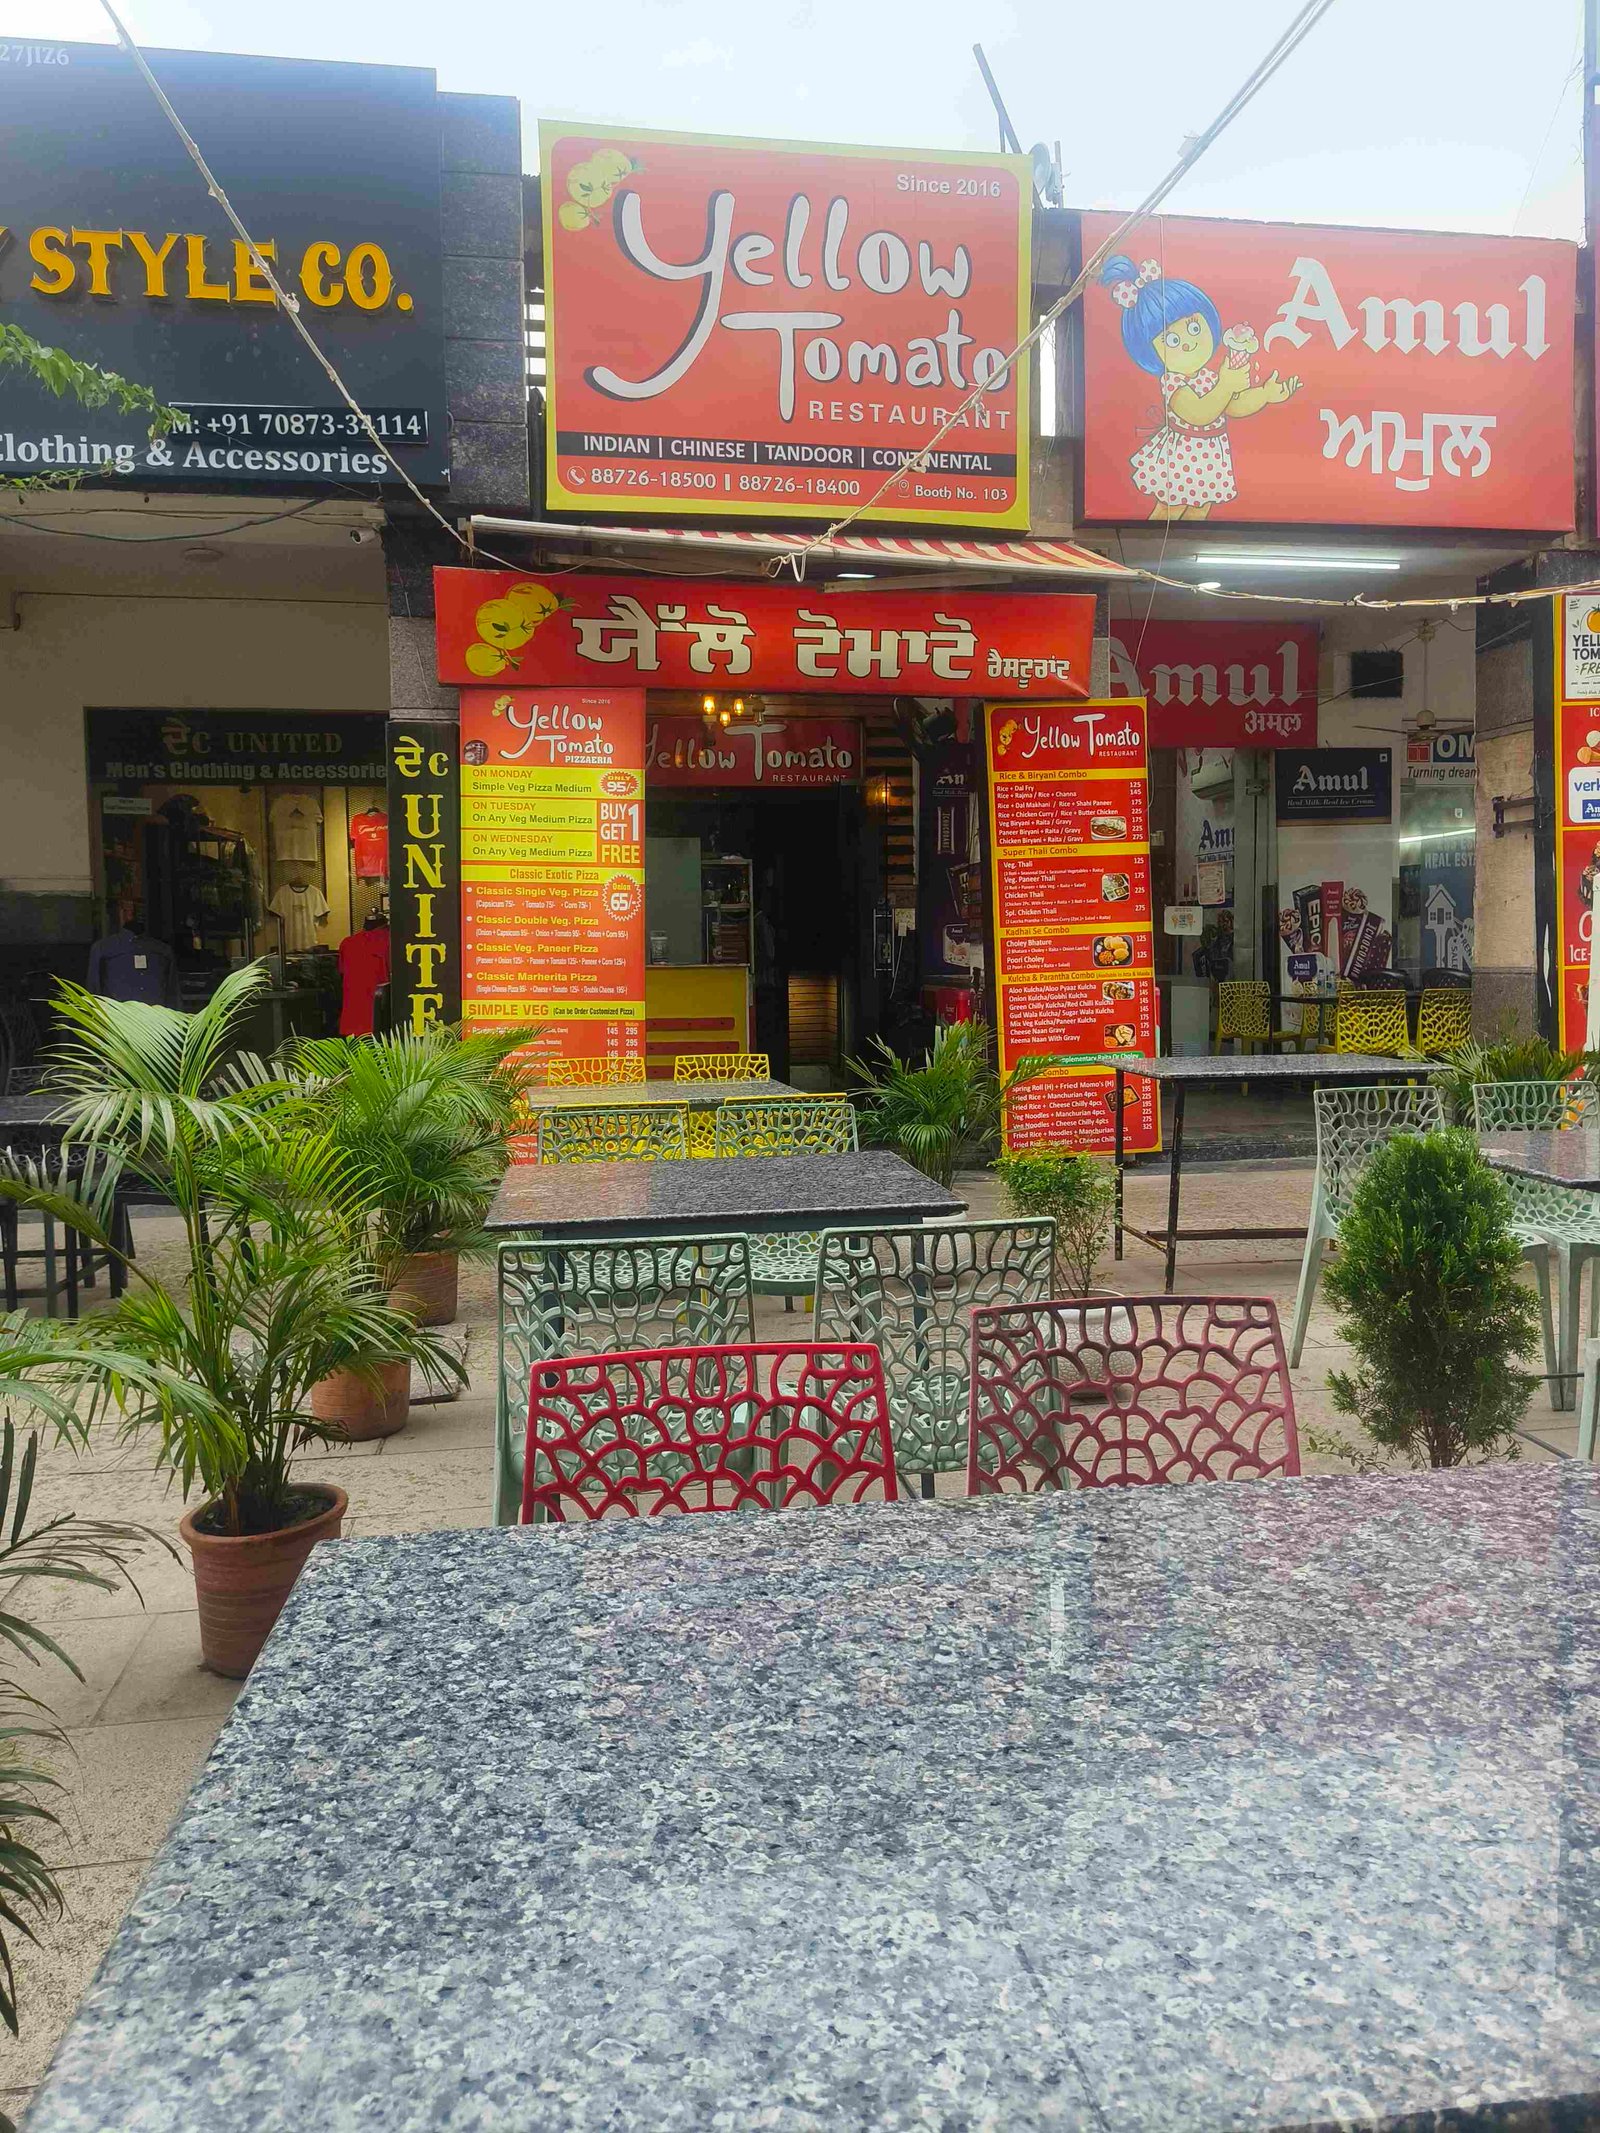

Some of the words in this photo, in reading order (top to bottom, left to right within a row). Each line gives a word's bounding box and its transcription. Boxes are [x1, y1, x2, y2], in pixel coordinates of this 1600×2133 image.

[897, 174, 950, 194] Since
[957, 178, 1001, 197] 2016
[29, 226, 279, 306] STYLE
[300, 241, 414, 310] CO.
[583, 189, 972, 401] Yellow
[1264, 257, 1551, 361] Amul
[720, 309, 1012, 424] Tomato
[809, 400, 1012, 431] RESTAURANT
[172, 413, 200, 434] M:
[206, 414, 251, 435] +91
[258, 413, 421, 437] 70873-34114
[146, 438, 174, 467] &
[182, 441, 388, 475] Accessories
[583, 434, 650, 454] INDIAN
[670, 439, 746, 459] CHINESE
[765, 444, 854, 465] TANDOOR
[872, 449, 992, 471] CONTNENTAL
[590, 468, 717, 489] 88726-18500
[739, 475, 860, 496] 88726-18400
[915, 483, 952, 499] Booth
[956, 485, 977, 500] No.
[982, 487, 1008, 501] 103
[1110, 637, 1303, 707] Amul
[500, 705, 603, 759] Yellow
[1245, 711, 1302, 737] अमूल
[227, 732, 342, 753] UNITED
[1021, 716, 1080, 759] Yellow
[1072, 713, 1141, 756] Tomato
[535, 733, 614, 763] Tomato
[724, 724, 853, 781] Tomato
[565, 756, 612, 764] PIZZAERIA
[105, 762, 166, 779] Men's
[169, 762, 255, 781] Clothing
[259, 763, 275, 778] &
[472, 770, 487, 778] ON
[489, 770, 533, 778] MONDAY
[1028, 771, 1056, 780] Biryani
[1058, 770, 1087, 778] Combo
[1293, 765, 1369, 794] Amul
[1408, 766, 1445, 780] Turning
[472, 782, 505, 792] Simple
[507, 783, 525, 793] Veg
[528, 784, 552, 792] Pizza
[555, 784, 592, 793] Medium
[607, 781, 634, 792] 95/-
[472, 802, 487, 810] ON
[490, 802, 536, 810] TUESDAY
[600, 803, 627, 819] BUY
[472, 814, 486, 822] On
[488, 814, 506, 824] Any
[509, 814, 527, 824] Veg
[529, 815, 566, 823] Medium
[569, 815, 592, 823] Pizza
[628, 804, 639, 841] 1
[472, 835, 487, 843] ON
[490, 835, 553, 843] WEDNESDAY
[600, 824, 627, 840] GET
[1199, 820, 1234, 849] Am
[472, 847, 486, 855] On
[488, 847, 506, 857] Any
[509, 847, 527, 857] Veg
[529, 848, 566, 856] Medium
[569, 848, 592, 857] Pizza
[602, 845, 640, 863] FREE
[1003, 849, 1026, 857] Super
[1029, 847, 1047, 855] Thali
[1050, 846, 1077, 854] Combo
[510, 869, 542, 879] Classic
[545, 870, 573, 880] Exotic
[576, 870, 599, 880] Pizza
[476, 887, 512, 895] Classic
[515, 887, 546, 897] Single
[549, 888, 571, 897] Veg.
[573, 888, 599, 896] Pizza
[611, 892, 636, 911] 65/-
[476, 916, 511, 924] Classic
[515, 916, 548, 924] Double
[551, 917, 571, 926] Veg.
[574, 917, 599, 925] Pizza
[1308, 899, 1321, 946] EPIC
[1005, 928, 1031, 936] Kadhai
[1043, 926, 1070, 934] Combo
[476, 943, 512, 951] Classic
[514, 944, 535, 953] Veg.
[538, 944, 571, 952] Paneer
[1294, 960, 1310, 969] Amul
[476, 972, 514, 980] Classic
[518, 972, 567, 981] Marherita
[570, 973, 597, 981] Pizza
[1008, 974, 1030, 982] Kulcha
[1040, 972, 1070, 981] Parantha
[1071, 971, 1095, 979] Combo
[468, 1004, 519, 1016] SIMPLE
[522, 1004, 549, 1016] VEG
[589, 1008, 619, 1016] Customized
[607, 1027, 619, 1035] 145
[607, 1039, 619, 1047] 145
[625, 1039, 638, 1047] 295
